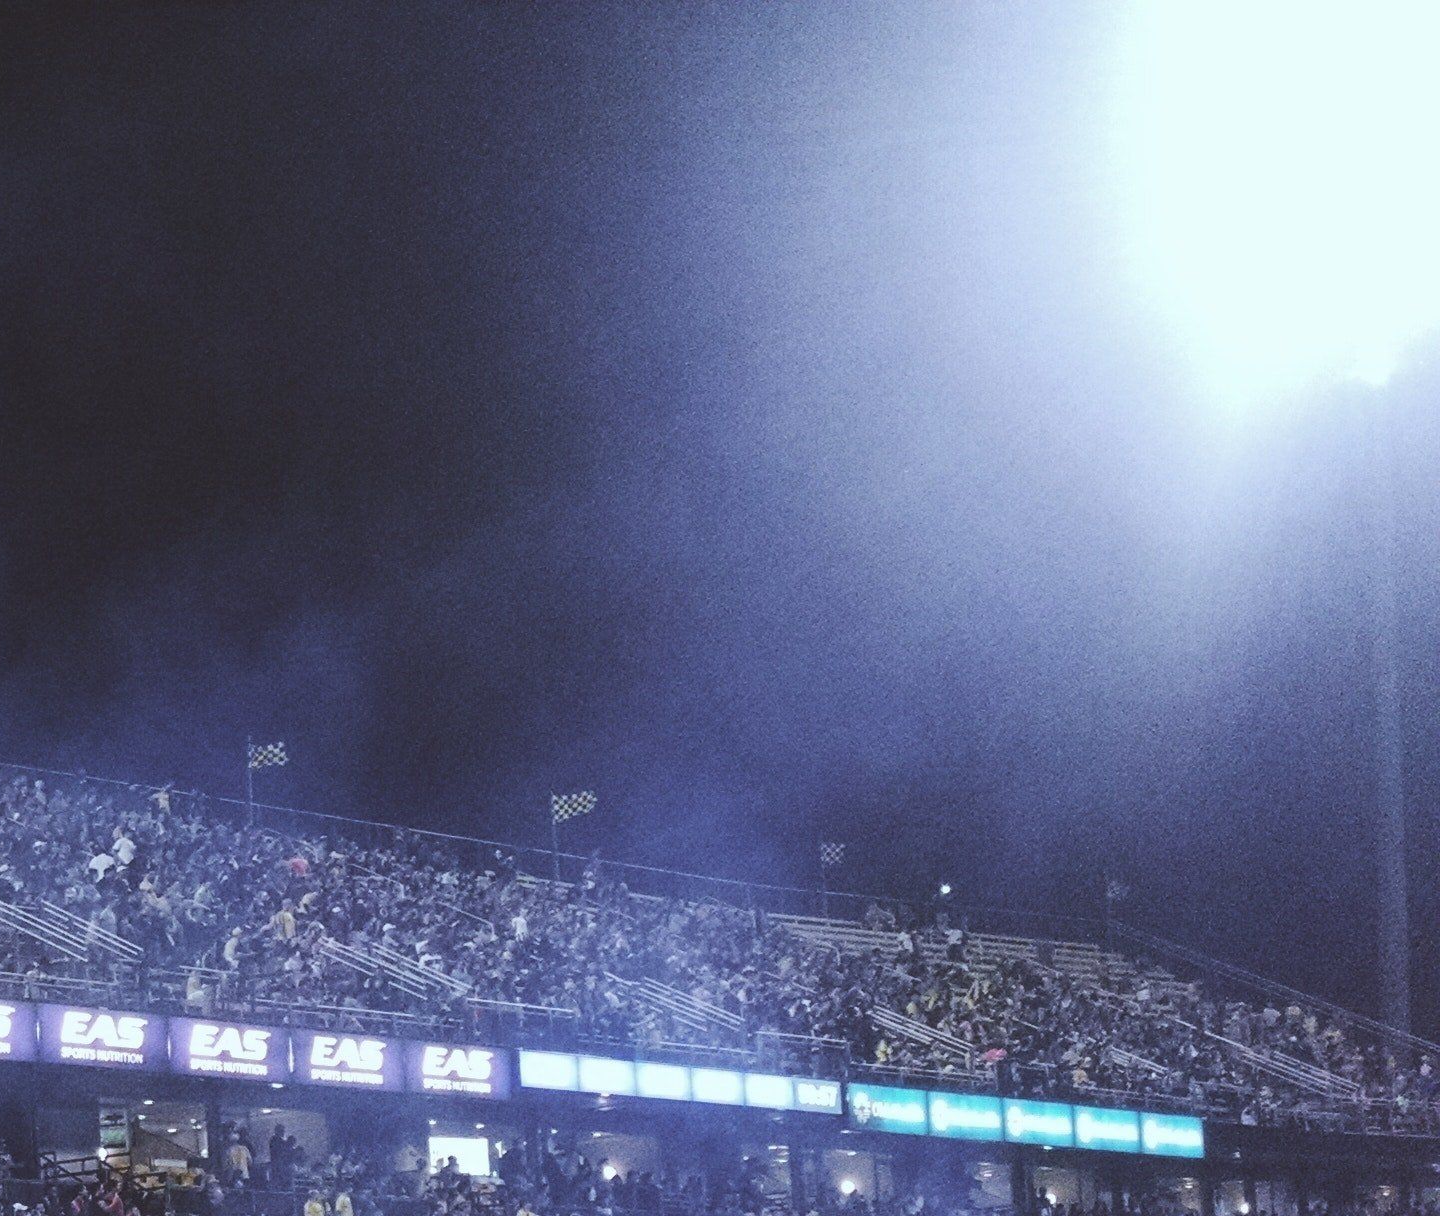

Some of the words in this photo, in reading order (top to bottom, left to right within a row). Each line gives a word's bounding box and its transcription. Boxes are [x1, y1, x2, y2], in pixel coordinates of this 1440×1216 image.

[60, 1010, 148, 1049] EAS
[189, 1024, 271, 1061] EAS
[60, 1046, 97, 1061] SPORTS
[97, 1050, 143, 1064] NUTRITION
[189, 1057, 223, 1072] SPORTS
[223, 1060, 268, 1076] NUTRITION
[310, 1035, 387, 1071] EAS
[421, 1045, 493, 1080] EAS
[310, 1068, 341, 1082] SPORTS
[341, 1071, 384, 1085] NUTRITION
[422, 1077, 454, 1090] SPORTS
[454, 1080, 492, 1094] NUTRITION
